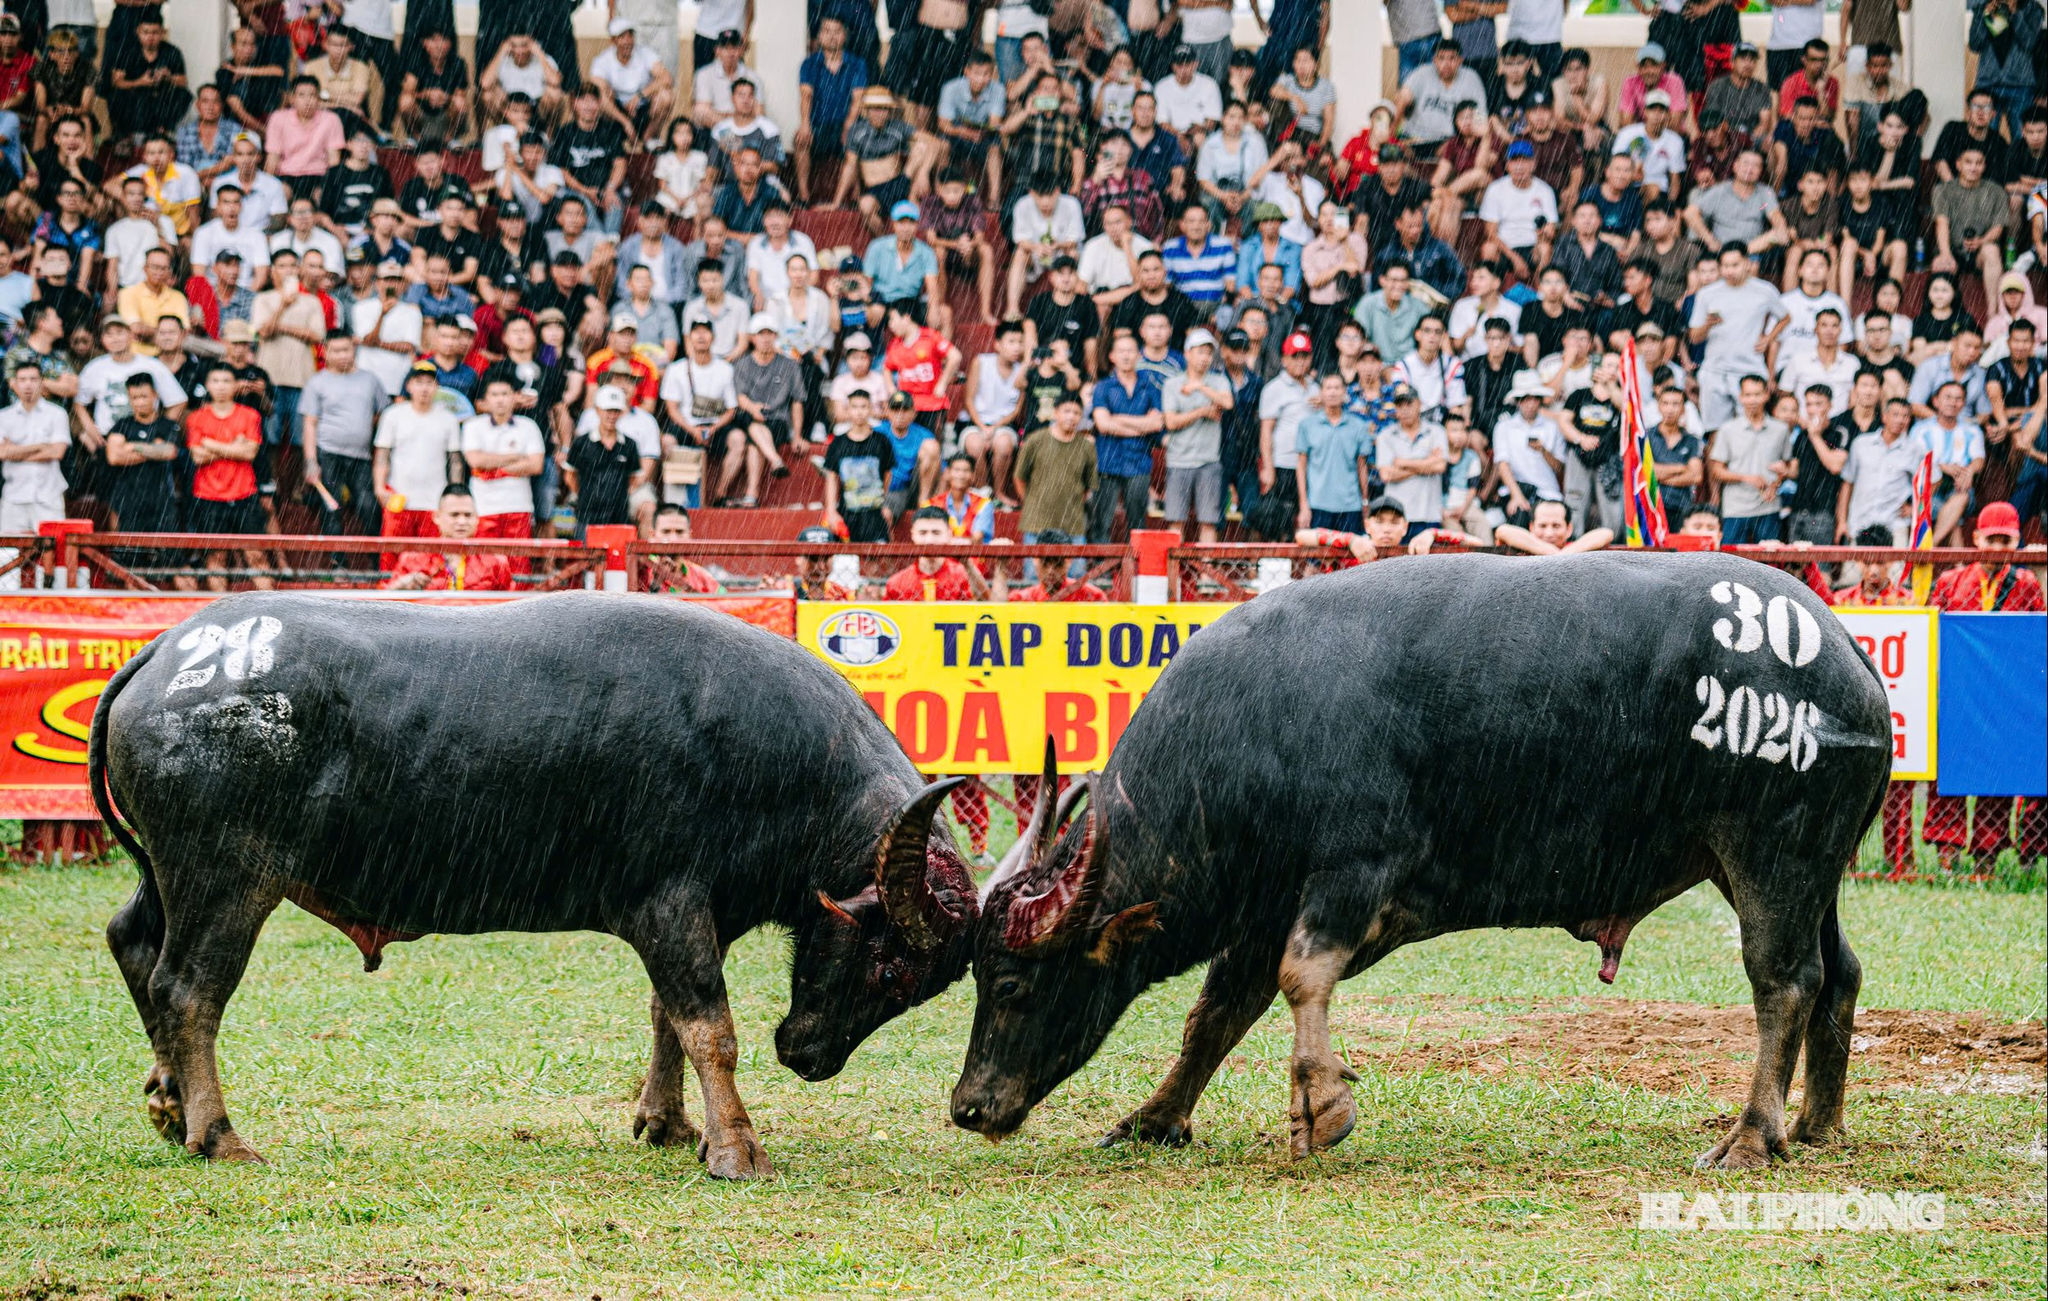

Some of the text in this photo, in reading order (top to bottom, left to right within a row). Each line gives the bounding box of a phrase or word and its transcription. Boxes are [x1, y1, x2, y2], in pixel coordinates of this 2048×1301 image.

[165, 616, 283, 698] 28
[934, 614, 1202, 677] TẬP ĐOÀ
[1710, 581, 1822, 668] 30
[864, 678, 1148, 763] OÀ BÌ
[1691, 675, 1820, 772] 2026
